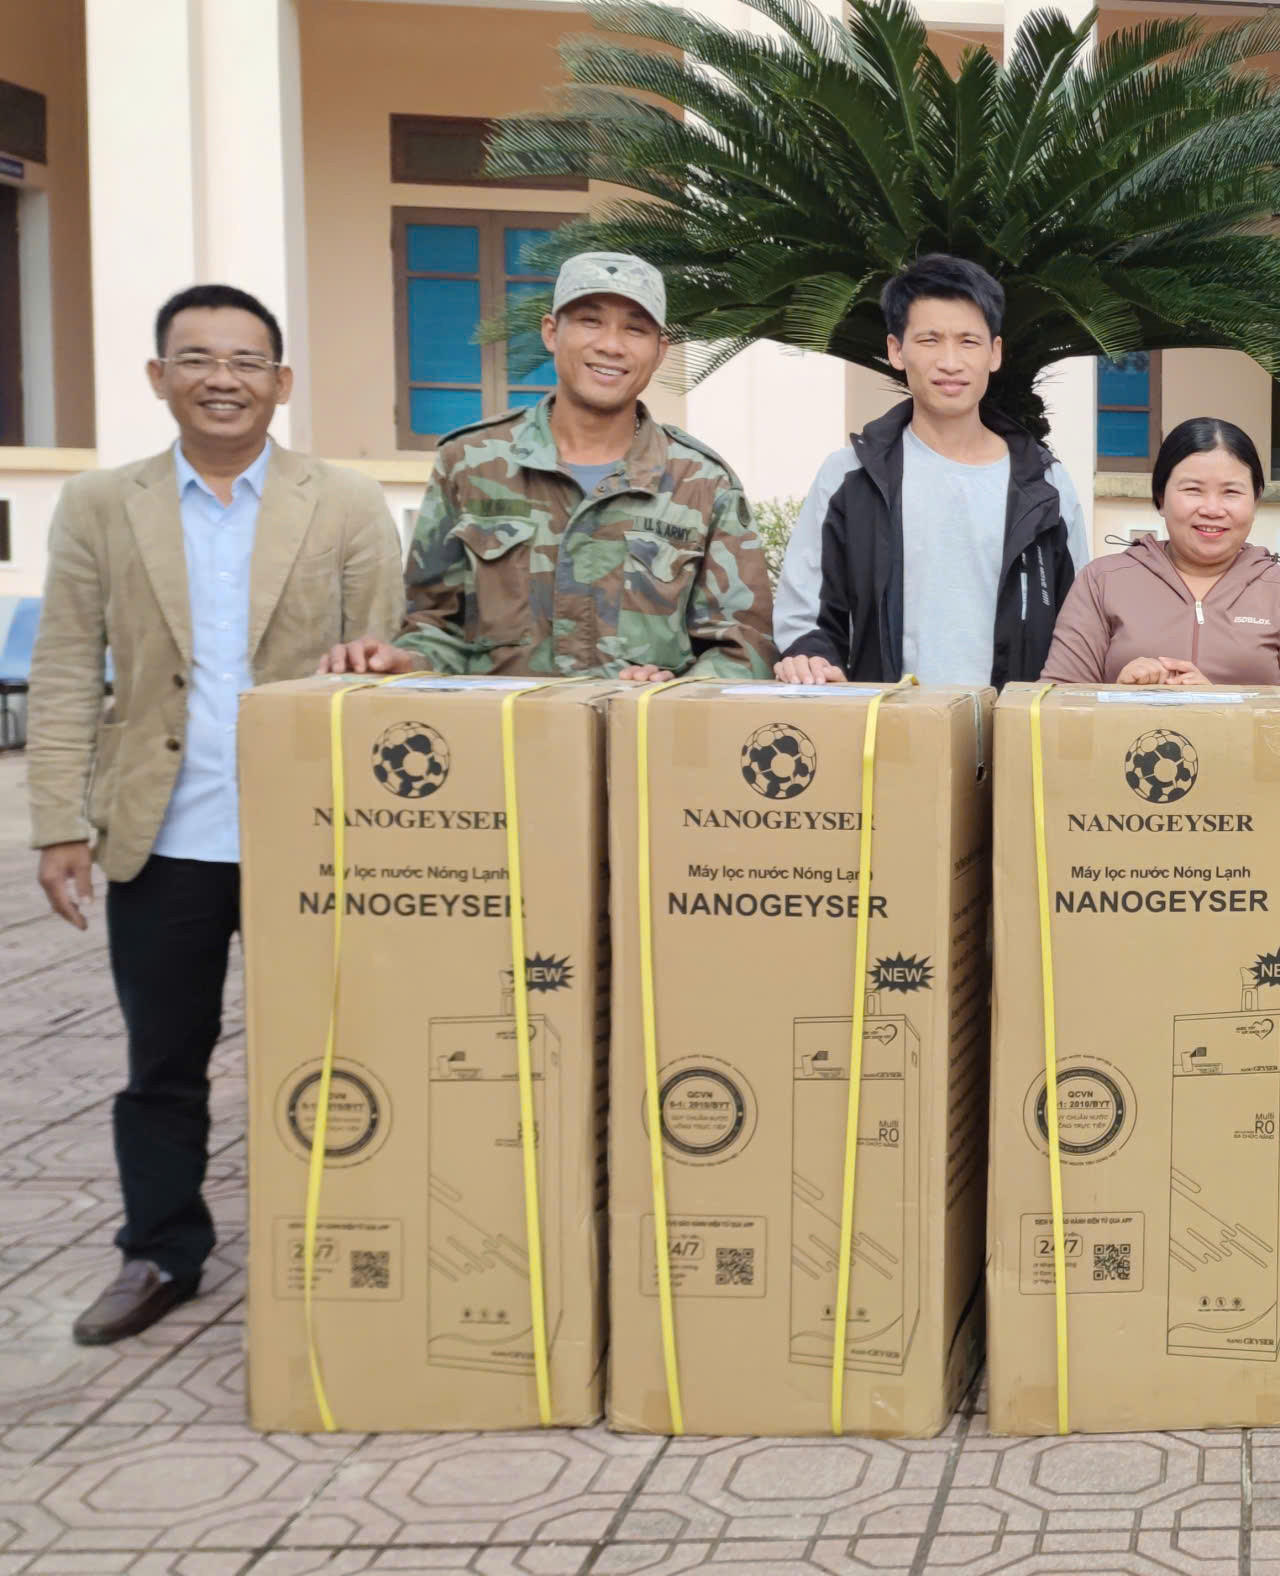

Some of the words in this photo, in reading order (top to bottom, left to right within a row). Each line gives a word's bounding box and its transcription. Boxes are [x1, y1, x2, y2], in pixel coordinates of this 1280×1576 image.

[1068, 814, 1254, 832] NANOGEYSER
[320, 864, 350, 880] My
[354, 865, 377, 881] lọc
[381, 866, 423, 879] nước
[427, 867, 468, 882] Nóng
[688, 864, 719, 881] Máy
[723, 865, 744, 881] lọc
[748, 865, 789, 880] nước
[793, 867, 832, 882] Nóng
[1071, 866, 1101, 881] Máy
[1105, 866, 1126, 881] lọc
[1130, 866, 1170, 879] nước
[1174, 866, 1211, 881] Nóng
[1216, 866, 1250, 881] Lạnh
[668, 891, 888, 918] NANOGEYSER
[1055, 890, 1269, 913] NANOGEYSER
[880, 967, 923, 982] NEW
[1067, 1091, 1093, 1099] QCVN
[1255, 1112, 1275, 1120] Multi
[1255, 1120, 1275, 1134] RO
[878, 1128, 900, 1143] RO
[669, 1241, 699, 1256] 4/7
[1040, 1239, 1078, 1254] 2/7
